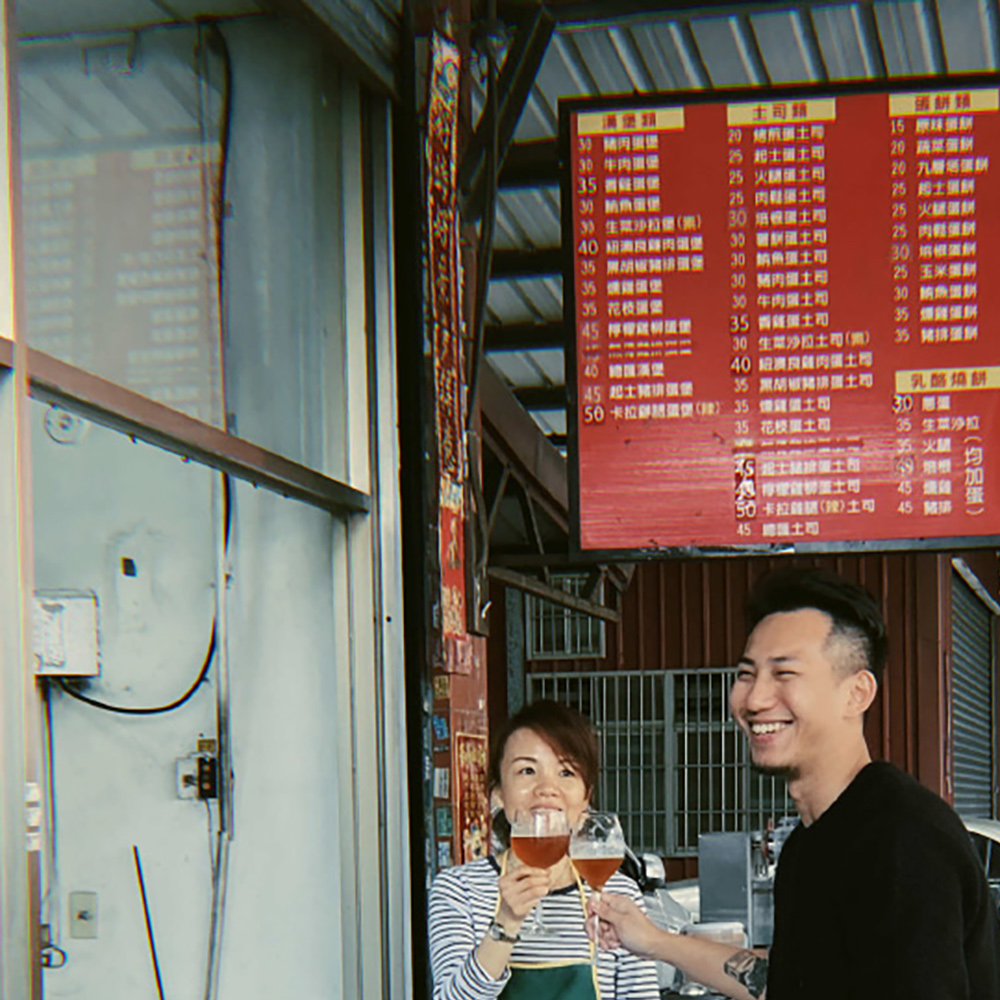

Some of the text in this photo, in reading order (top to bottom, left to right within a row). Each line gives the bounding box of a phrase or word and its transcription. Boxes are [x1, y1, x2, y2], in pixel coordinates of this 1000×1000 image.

[915, 94, 971, 111] 蛋餅類
[753, 103, 807, 120] 土司類
[891, 120, 904, 132] 15
[891, 141, 904, 154] 20
[892, 162, 906, 175] 20
[729, 171, 743, 184] 25
[578, 178, 596, 193] 35
[892, 183, 906, 196] 25
[729, 192, 744, 204] 25
[892, 203, 906, 216] 25
[892, 225, 907, 238] 25
[731, 233, 745, 246] 30
[578, 240, 598, 254] 40
[731, 254, 745, 266] 30
[894, 266, 908, 278] 25
[731, 274, 745, 287] 30
[894, 286, 908, 300] 30
[732, 295, 746, 308] 30
[894, 308, 908, 321] 35
[730, 315, 749, 332] 35
[895, 329, 909, 342] 35
[731, 358, 751, 373] 40
[585, 406, 604, 422] 50
